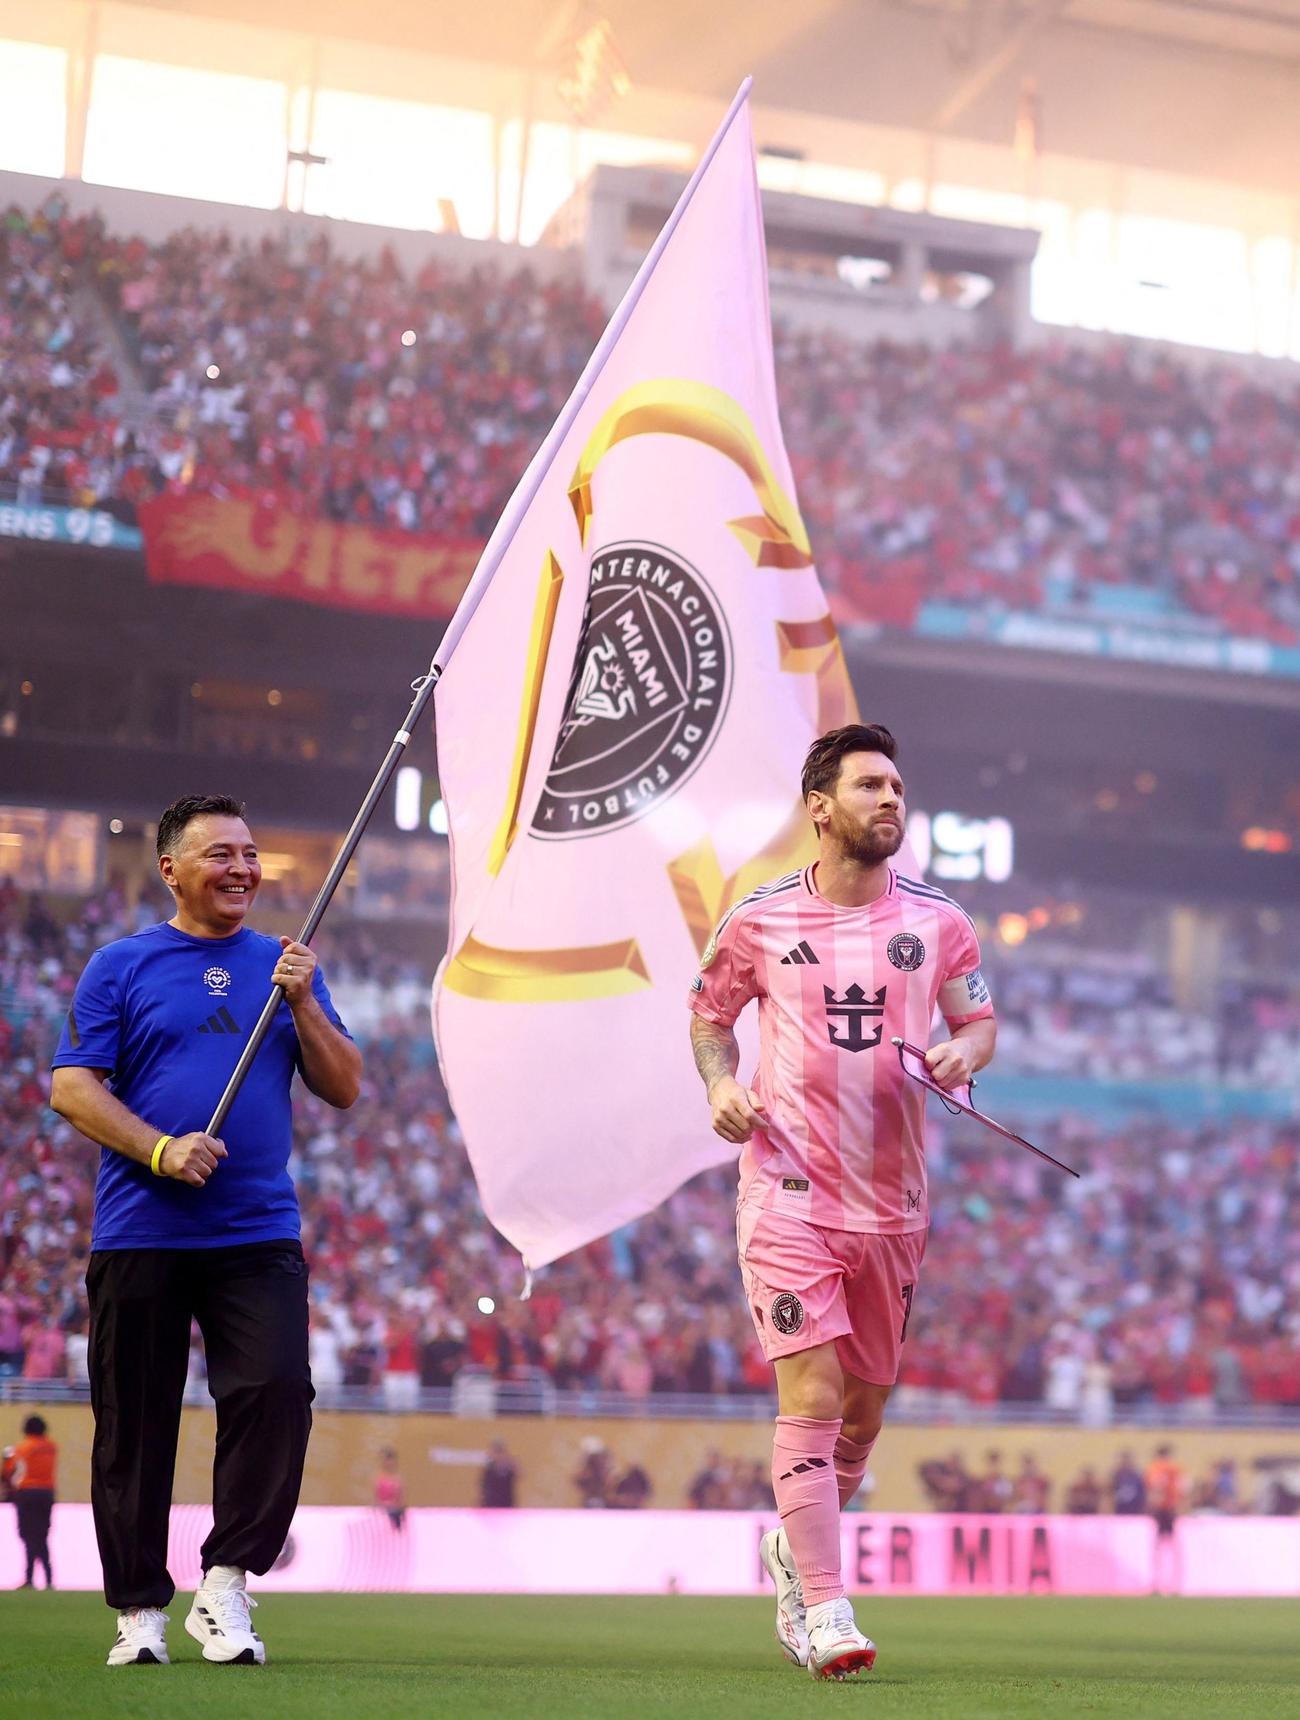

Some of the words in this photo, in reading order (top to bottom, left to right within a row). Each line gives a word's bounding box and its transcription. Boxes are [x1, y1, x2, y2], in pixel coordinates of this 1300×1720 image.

[591, 557, 718, 711] NTERNACIONAL
[671, 723, 703, 762] DE
[615, 609, 668, 708] MIAMI
[758, 1525, 914, 1585] IER
